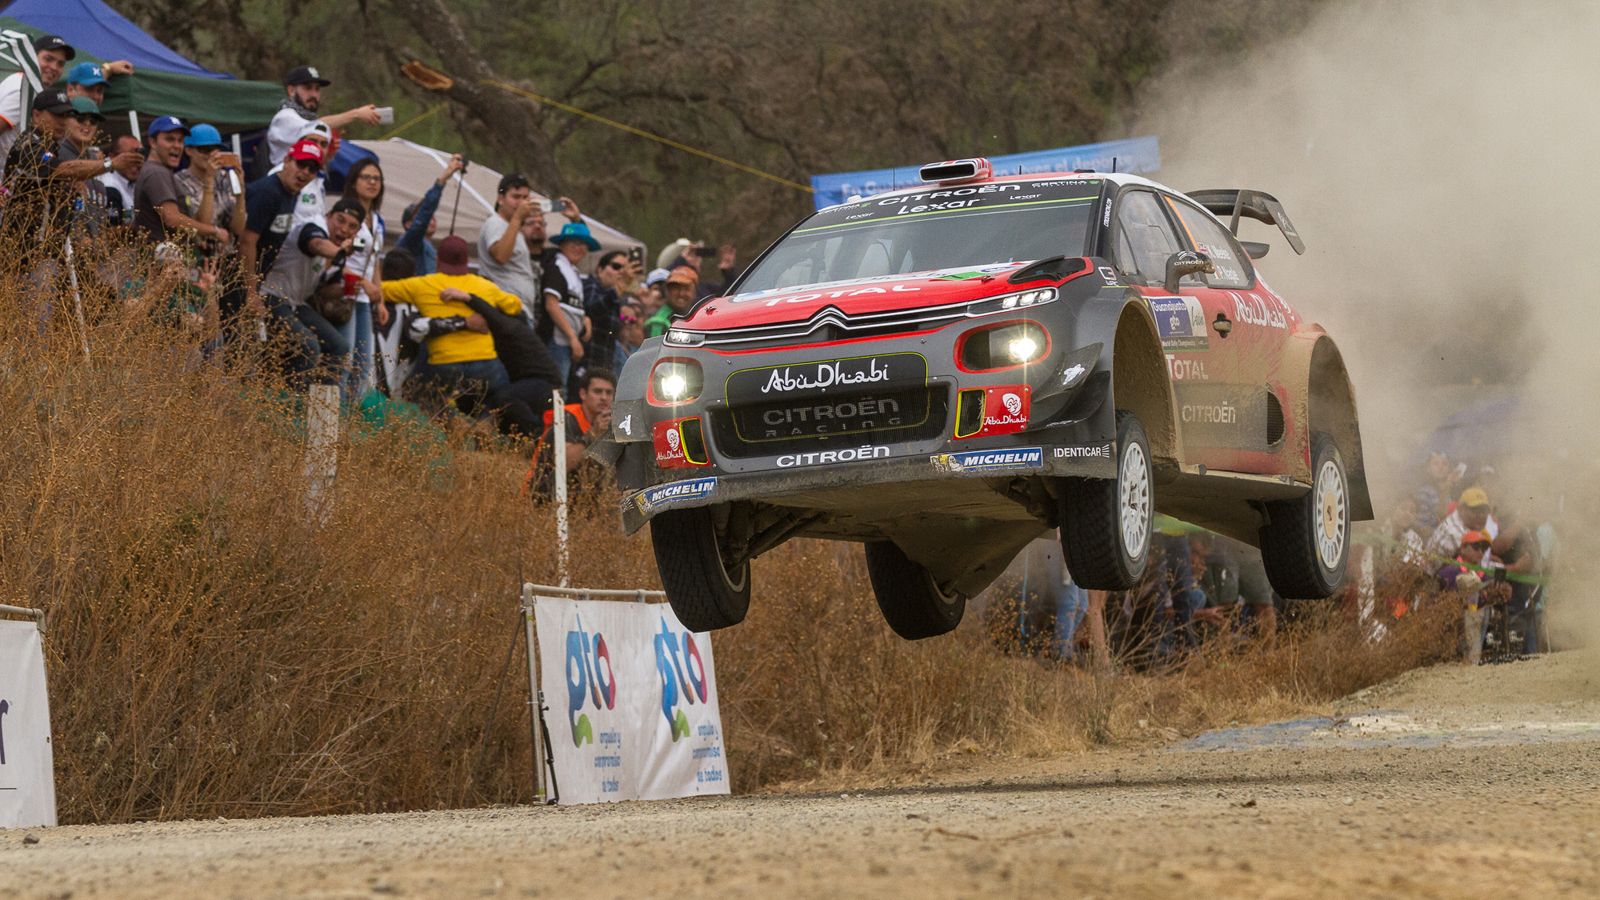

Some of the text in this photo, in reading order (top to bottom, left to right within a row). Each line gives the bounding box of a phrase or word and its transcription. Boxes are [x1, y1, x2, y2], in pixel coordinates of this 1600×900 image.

[878, 184, 1020, 206] CITROËN
[898, 198, 981, 215] Lexar
[764, 284, 921, 307] TOTAL
[1166, 354, 1209, 379] TOTAL
[762, 396, 899, 425] CITROËN
[1182, 401, 1236, 424] CITROËN
[766, 417, 902, 437] RACING
[776, 445, 890, 468] CITROËN
[964, 452, 1040, 466] MICHELIN
[1054, 447, 1102, 458] IDENTICAR
[652, 482, 714, 501] MICHELIN
